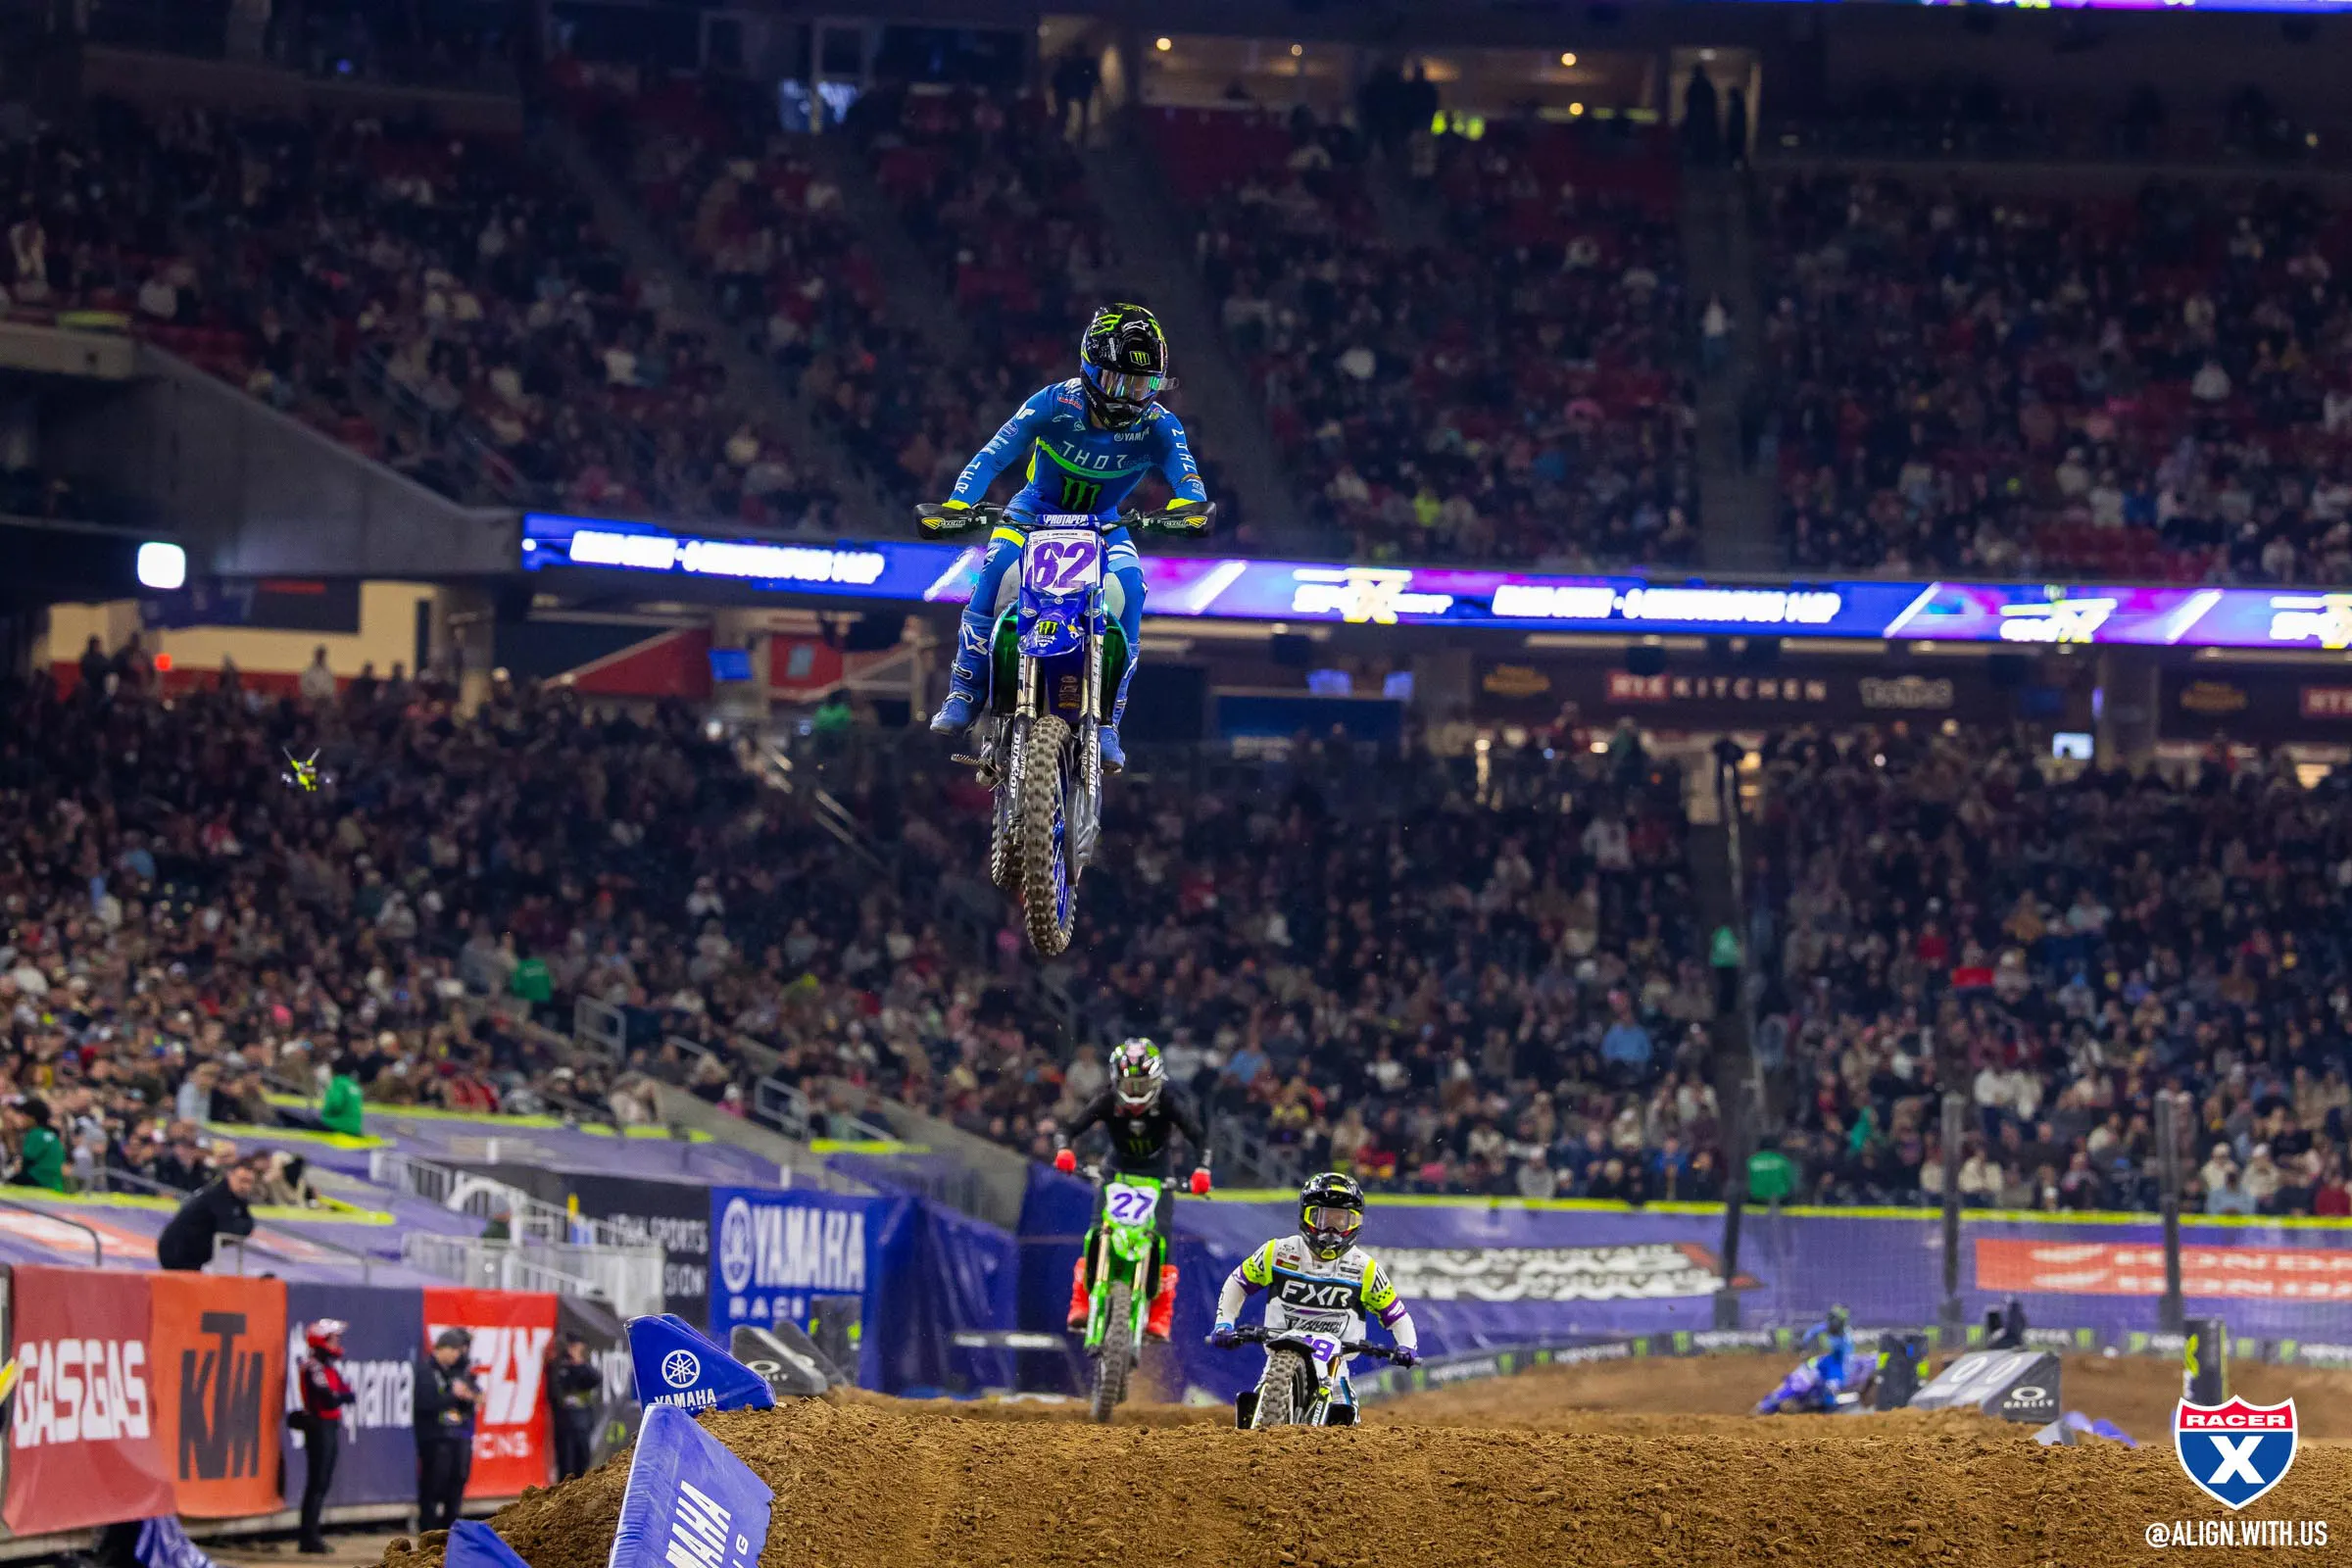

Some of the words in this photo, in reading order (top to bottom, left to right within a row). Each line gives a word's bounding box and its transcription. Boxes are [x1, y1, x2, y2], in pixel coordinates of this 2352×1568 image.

[1061, 440, 1128, 470] THOR
[1111, 1192, 1153, 1220] 27
[755, 1204, 866, 1292] YAMAHA
[1282, 1279, 1353, 1307] FXR
[1303, 1335, 1335, 1362] 9
[13, 1339, 150, 1448] GASGAS
[178, 1310, 264, 1481] KTM
[654, 1388, 717, 1408] YAMAHA
[2003, 1398, 2055, 1409] OAKLEY
[665, 1479, 731, 1568] MAHA
